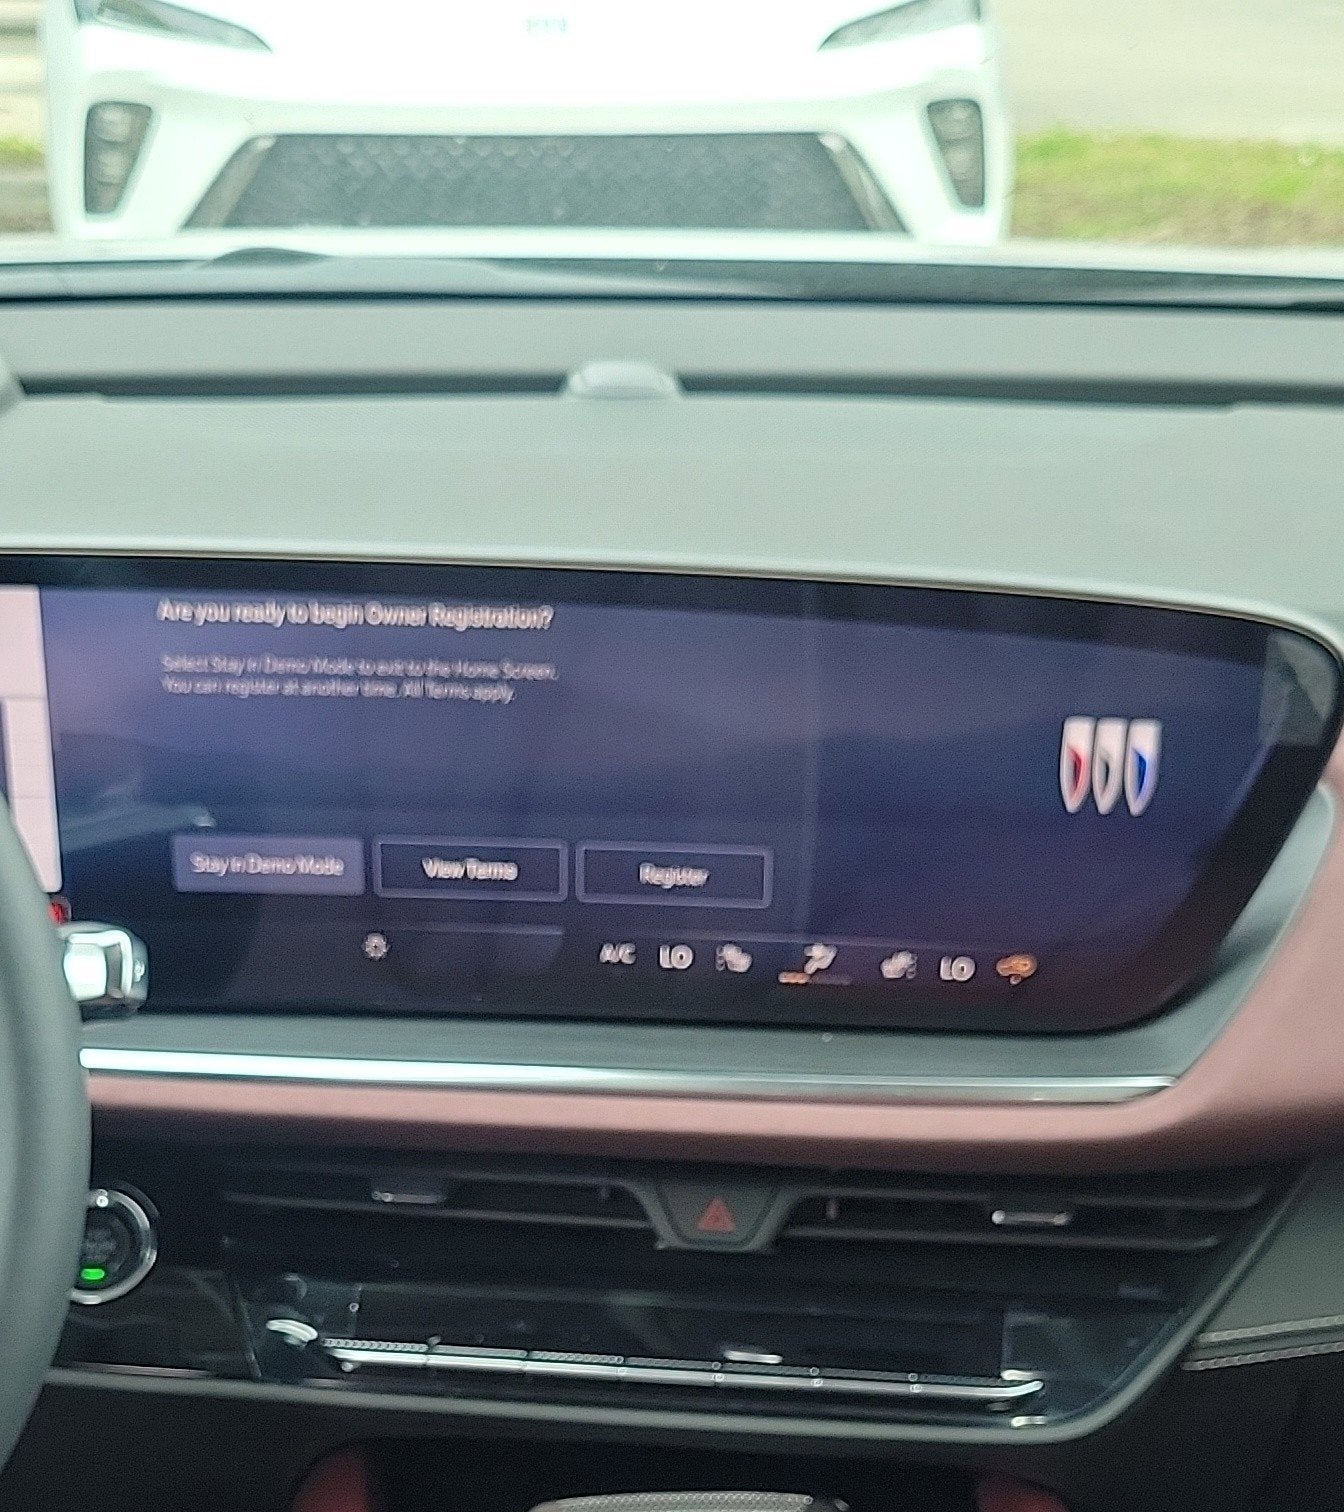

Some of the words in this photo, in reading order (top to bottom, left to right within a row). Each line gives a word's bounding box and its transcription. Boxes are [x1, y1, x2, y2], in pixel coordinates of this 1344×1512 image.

[157, 598, 193, 622] Are
[194, 602, 231, 627] you
[231, 599, 285, 627] ready
[286, 601, 309, 624] to
[309, 600, 364, 628] begin
[364, 601, 427, 626] Owner
[427, 602, 555, 631] Registration?
[208, 655, 245, 677] Stay
[159, 672, 192, 695] You
[188, 851, 230, 877] Stay
[244, 852, 296, 875] Demo
[294, 853, 345, 877] Mode
[422, 857, 465, 880] View
[466, 858, 518, 881] Terms
[639, 862, 711, 889] Register
[659, 944, 694, 970] LO
[940, 955, 976, 982] LO
